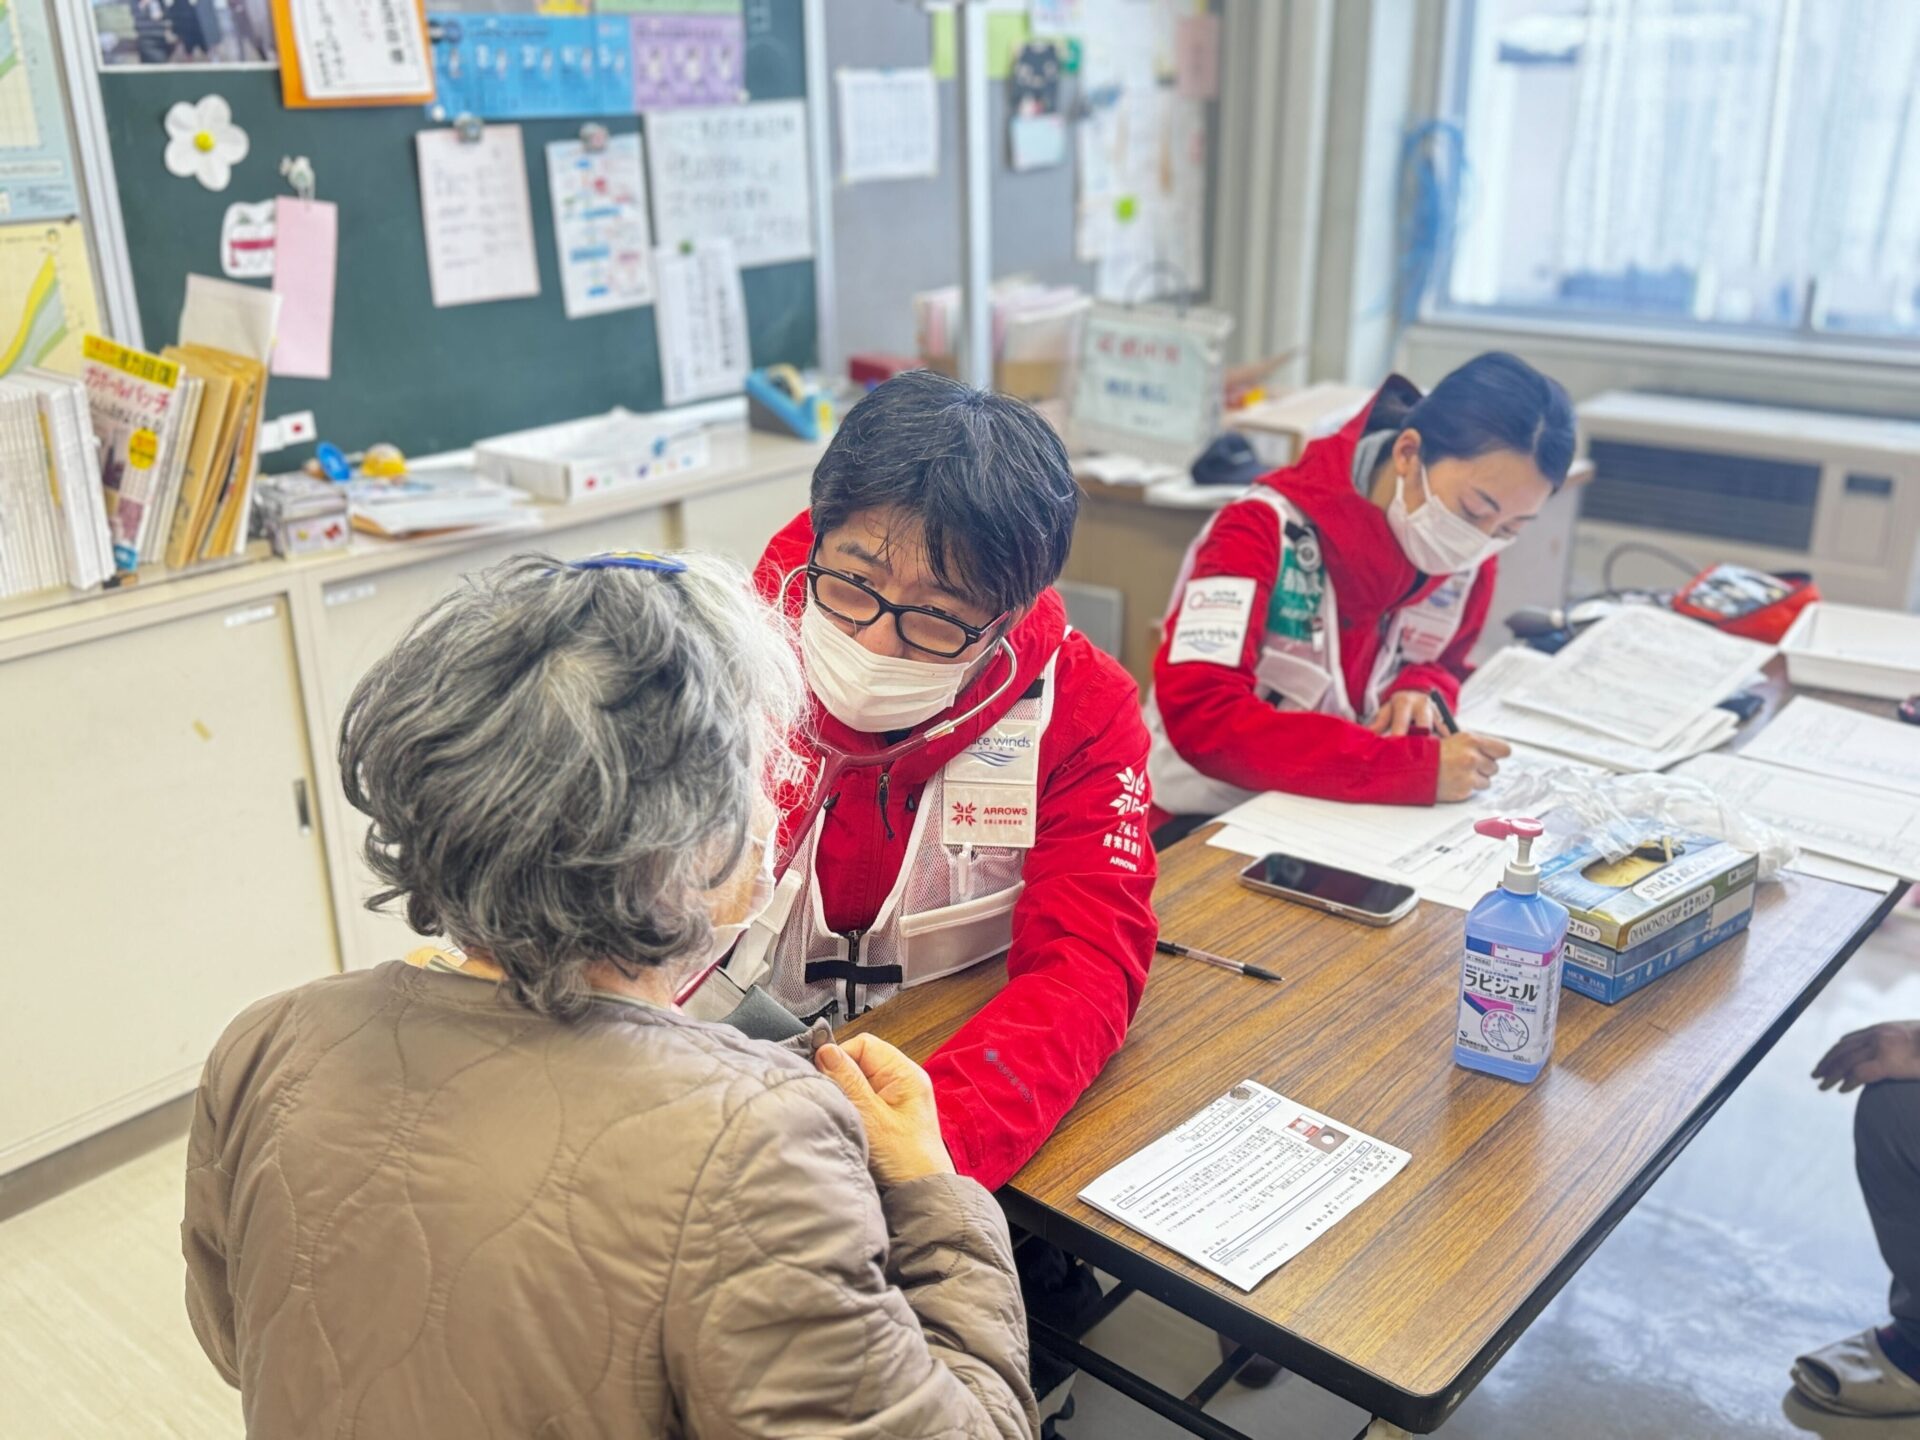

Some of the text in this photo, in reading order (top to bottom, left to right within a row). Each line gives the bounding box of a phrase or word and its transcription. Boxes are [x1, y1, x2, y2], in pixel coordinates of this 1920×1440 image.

[993, 736, 1031, 748] winds
[983, 807, 1028, 816] ARROWS
[1109, 856, 1137, 873] ARROWS
[1576, 923, 1595, 937] PLUS
[1465, 968, 1538, 1002] ラビジェル
